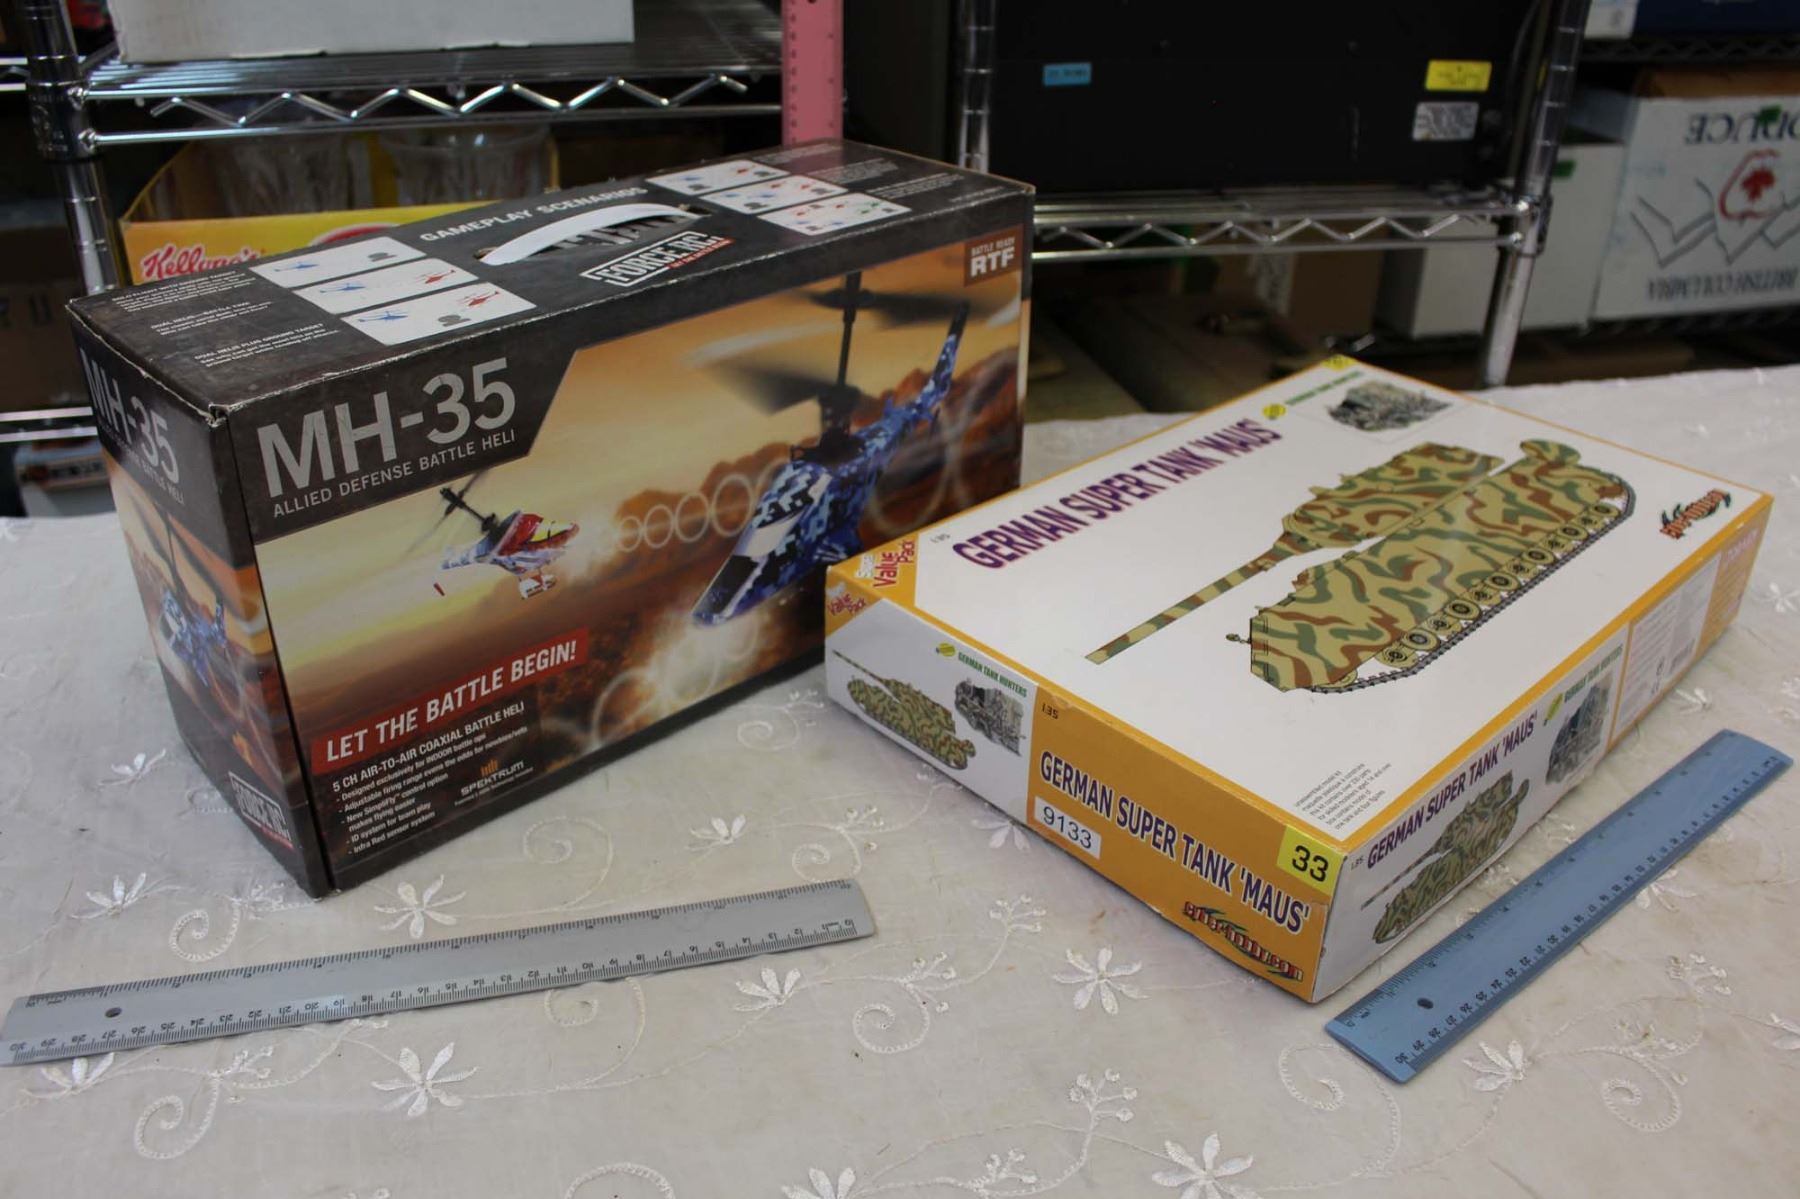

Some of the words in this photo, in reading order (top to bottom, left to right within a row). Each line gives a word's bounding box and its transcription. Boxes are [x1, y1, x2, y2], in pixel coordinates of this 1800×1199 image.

[420, 210, 533, 242] GAMEPLAY
[536, 187, 649, 214] SCENARIOS
[971, 246, 1015, 277] RTF
[80, 348, 180, 484] MH-35
[257, 357, 516, 498] MH-35
[274, 488, 332, 517] ALLIED
[340, 462, 413, 496] DEFENSE
[420, 441, 476, 471] BATTLE
[482, 429, 515, 451] HELI
[952, 506, 1091, 569] GERMAN
[1059, 473, 1168, 519] SUPER
[1131, 446, 1225, 484] TANK
[873, 552, 898, 587] Value
[327, 729, 368, 762] LET
[375, 708, 418, 744] THE
[426, 667, 504, 723] BATTLE
[511, 640, 576, 682] BEGIN!
[333, 780, 340, 792] 5
[342, 774, 358, 788] CH
[360, 748, 417, 781] AIR-TO-AIR
[419, 729, 463, 754] COAXIAL
[465, 711, 502, 735] BATTLE
[503, 701, 525, 719] HELI
[342, 780, 375, 800] Designed
[1368, 806, 1424, 869] GERMAN
[1426, 772, 1467, 822] SUPER
[1469, 743, 1500, 786] TANK
[1502, 710, 1538, 757] 'MAUS'
[1040, 751, 1113, 819] GERMAN
[1117, 796, 1176, 858] SUPER
[1182, 834, 1235, 893] TANK
[1241, 867, 1310, 933] 'MAUS'
[1043, 806, 1092, 849] 9133
[1292, 846, 1329, 882] 33
